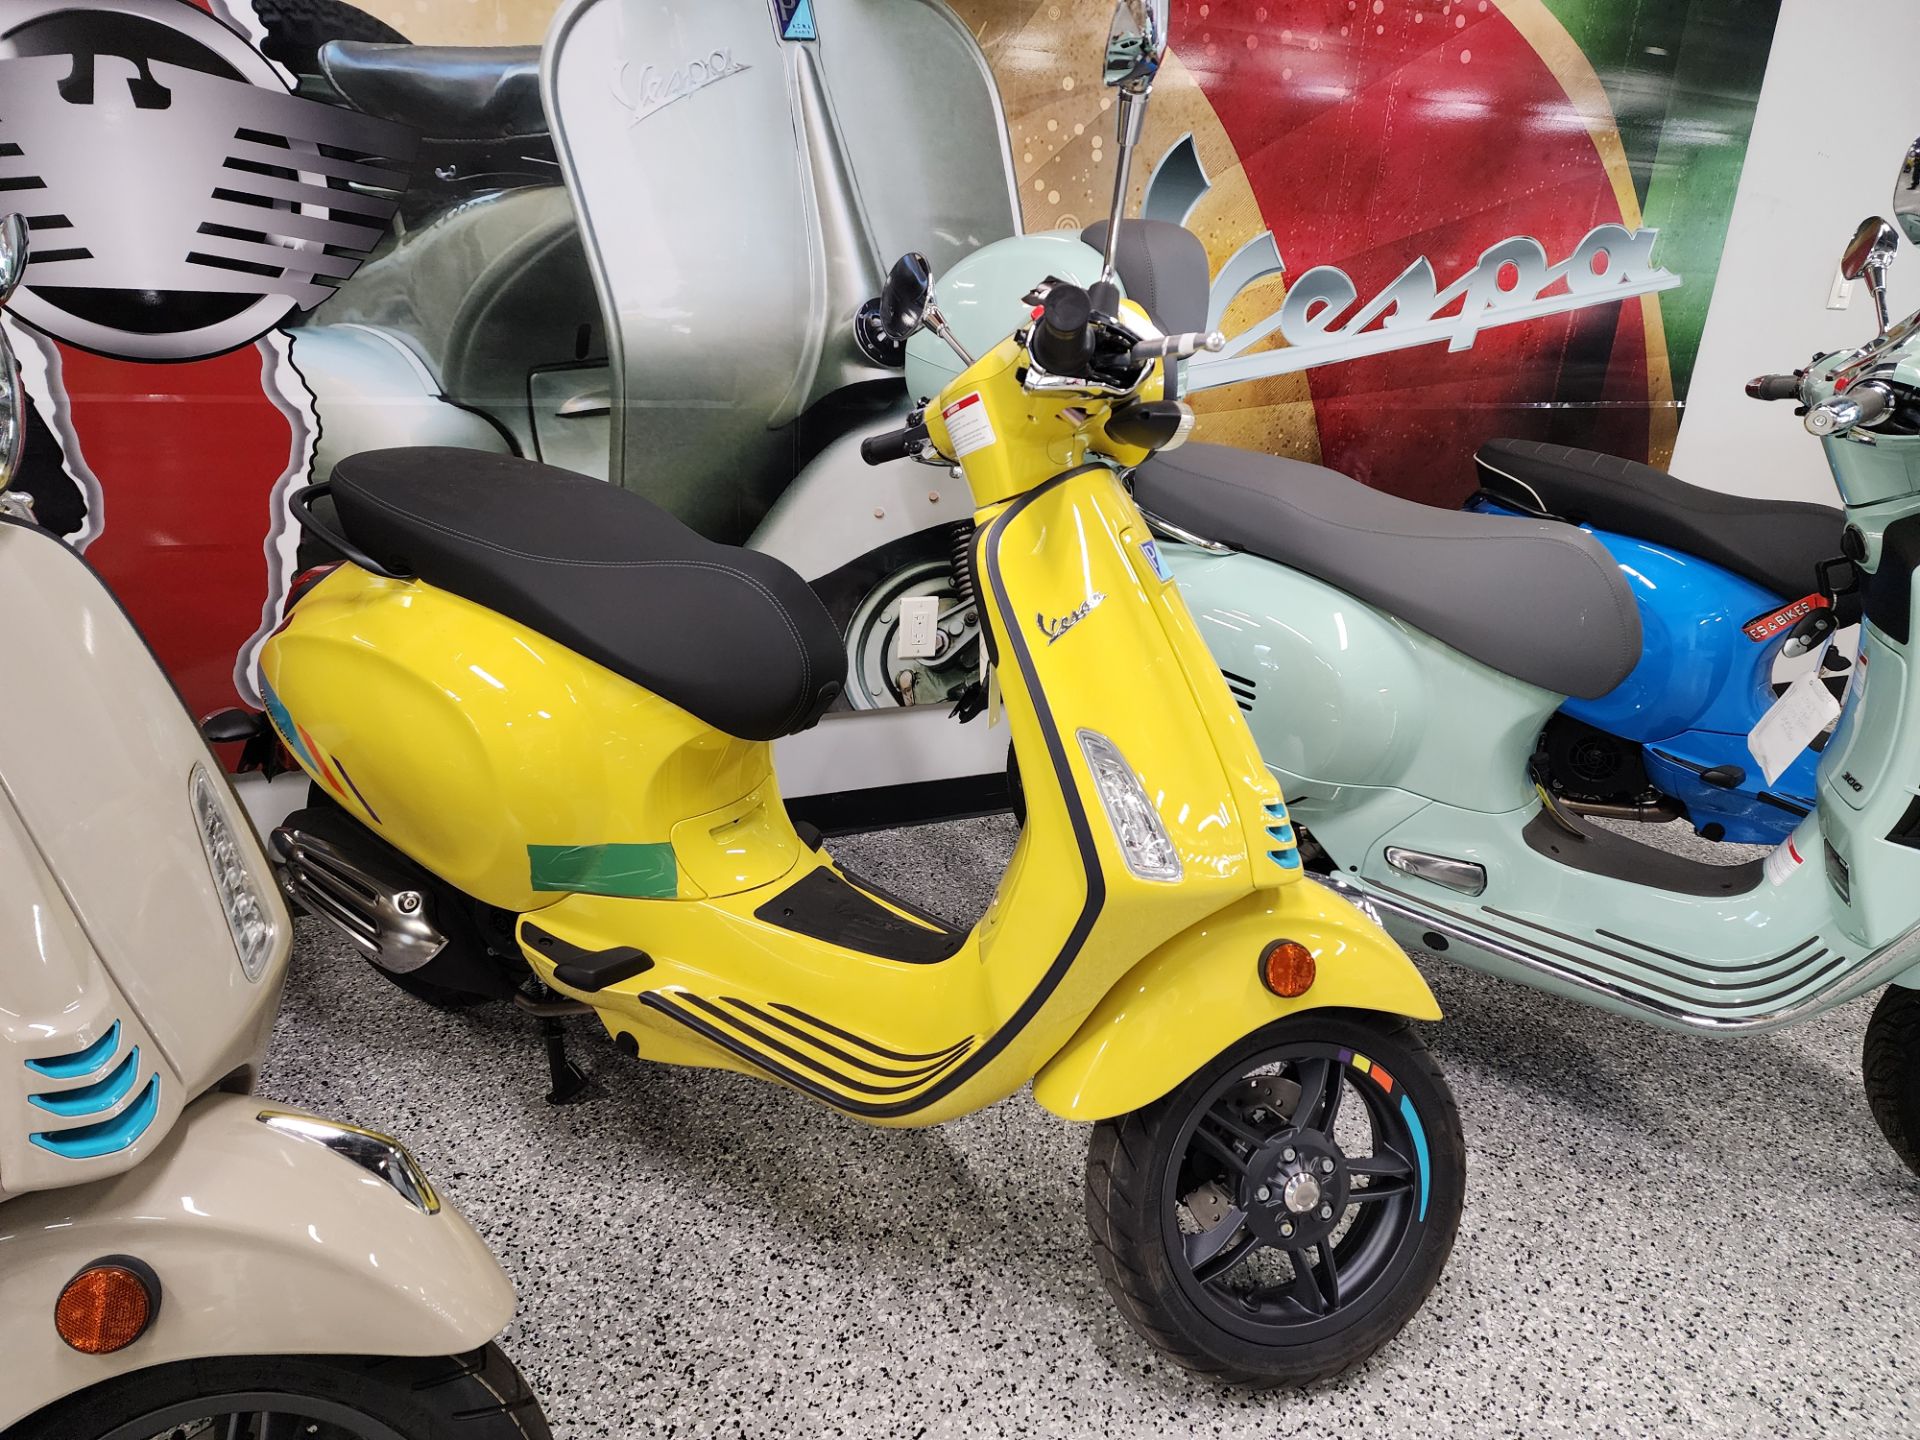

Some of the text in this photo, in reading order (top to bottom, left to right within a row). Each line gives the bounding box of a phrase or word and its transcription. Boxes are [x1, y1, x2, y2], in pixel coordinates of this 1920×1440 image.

[1143, 132, 1682, 392] Vespa
[1768, 622, 1778, 632] &
[1774, 601, 1811, 626] BIKES
